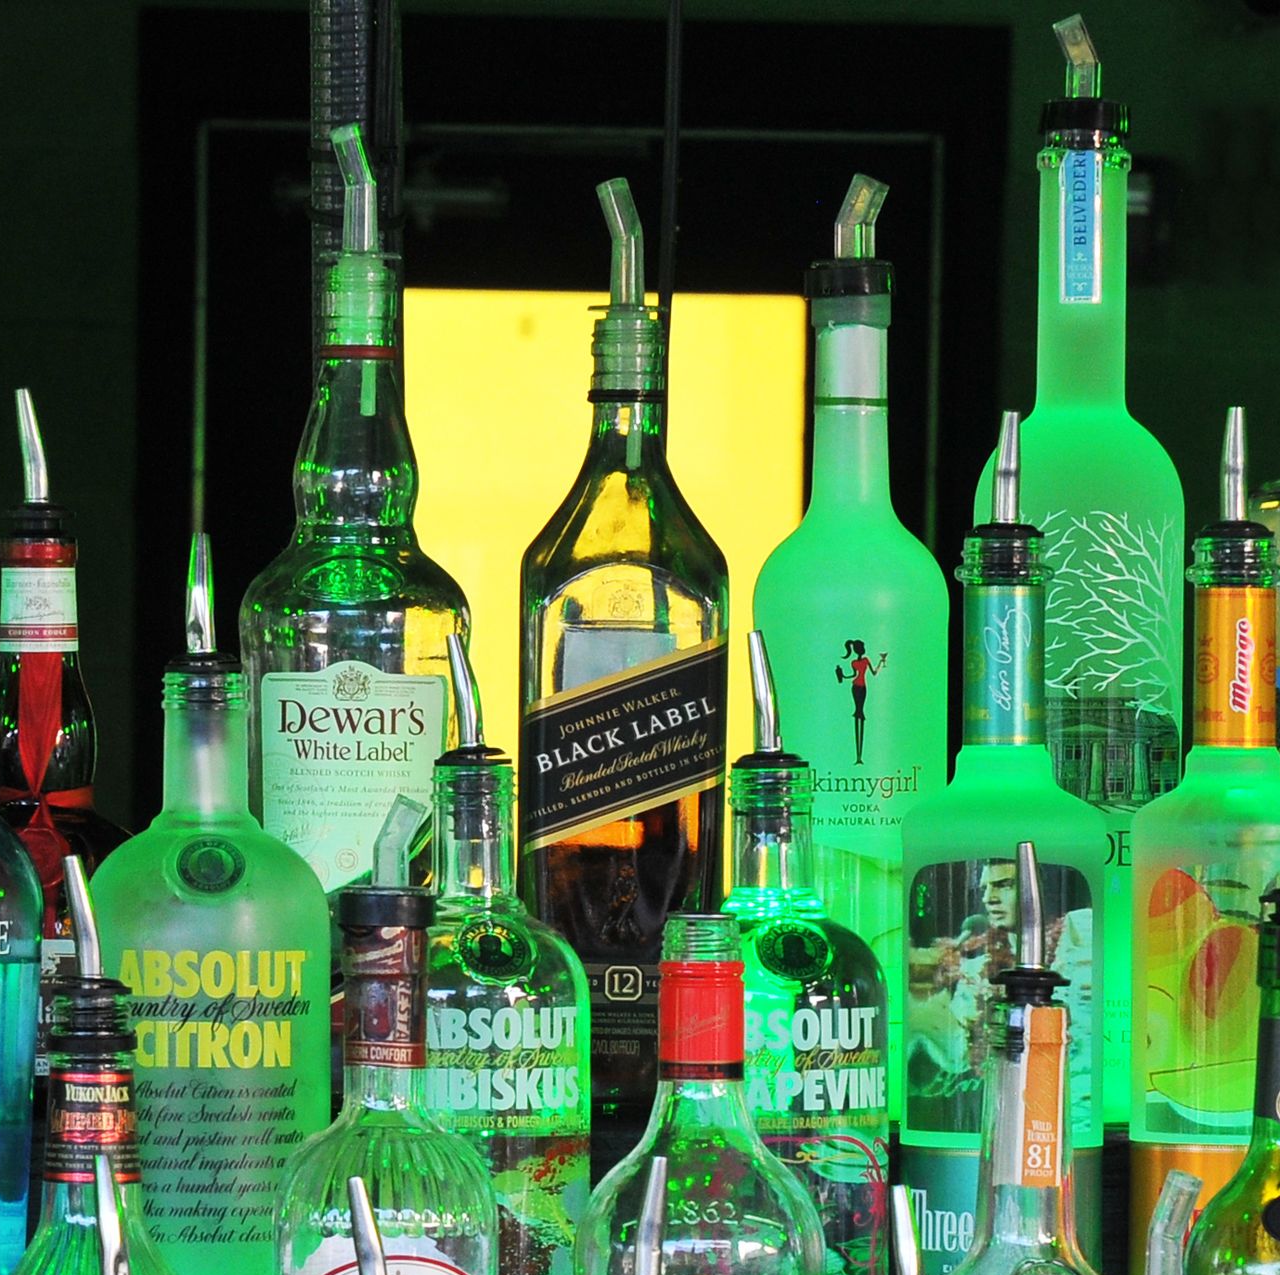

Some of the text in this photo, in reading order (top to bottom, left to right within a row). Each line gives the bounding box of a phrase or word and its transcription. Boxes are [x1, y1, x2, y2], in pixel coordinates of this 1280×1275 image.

[1229, 618, 1251, 713] Mango
[278, 700, 424, 735] Dewar's
[559, 688, 679, 739] JOHNNIE WALKER
[536, 697, 716, 773] BLACK LABEL
[559, 729, 707, 792] Blended Scotch Whisky
[812, 766, 918, 798] kinnygirl
[842, 804, 880, 812] VODKA
[828, 817, 875, 826] NATURAL
[120, 950, 306, 998] ABSOLUT
[610, 974, 634, 993] 12
[200, 991, 311, 1033] of Sweden
[426, 1007, 577, 1050] ABSOLUT
[745, 1007, 876, 1050] BSOLUT
[135, 1020, 291, 1068] CITRON
[370, 1047, 413, 1062] COMFORT
[65, 1084, 130, 1102] YUKON JACK
[135, 1079, 297, 1098] Absolut Citron created
[156, 1104, 295, 1128] fine Swedish winter
[153, 1128, 273, 1152] and pristine well
[198, 1154, 274, 1176] ingredients
[1027, 1145, 1051, 1169] 81
[176, 1176, 237, 1194] hundred
[169, 1200, 228, 1223] making
[911, 1189, 975, 1252] Three
[167, 1225, 235, 1243] Absolut
